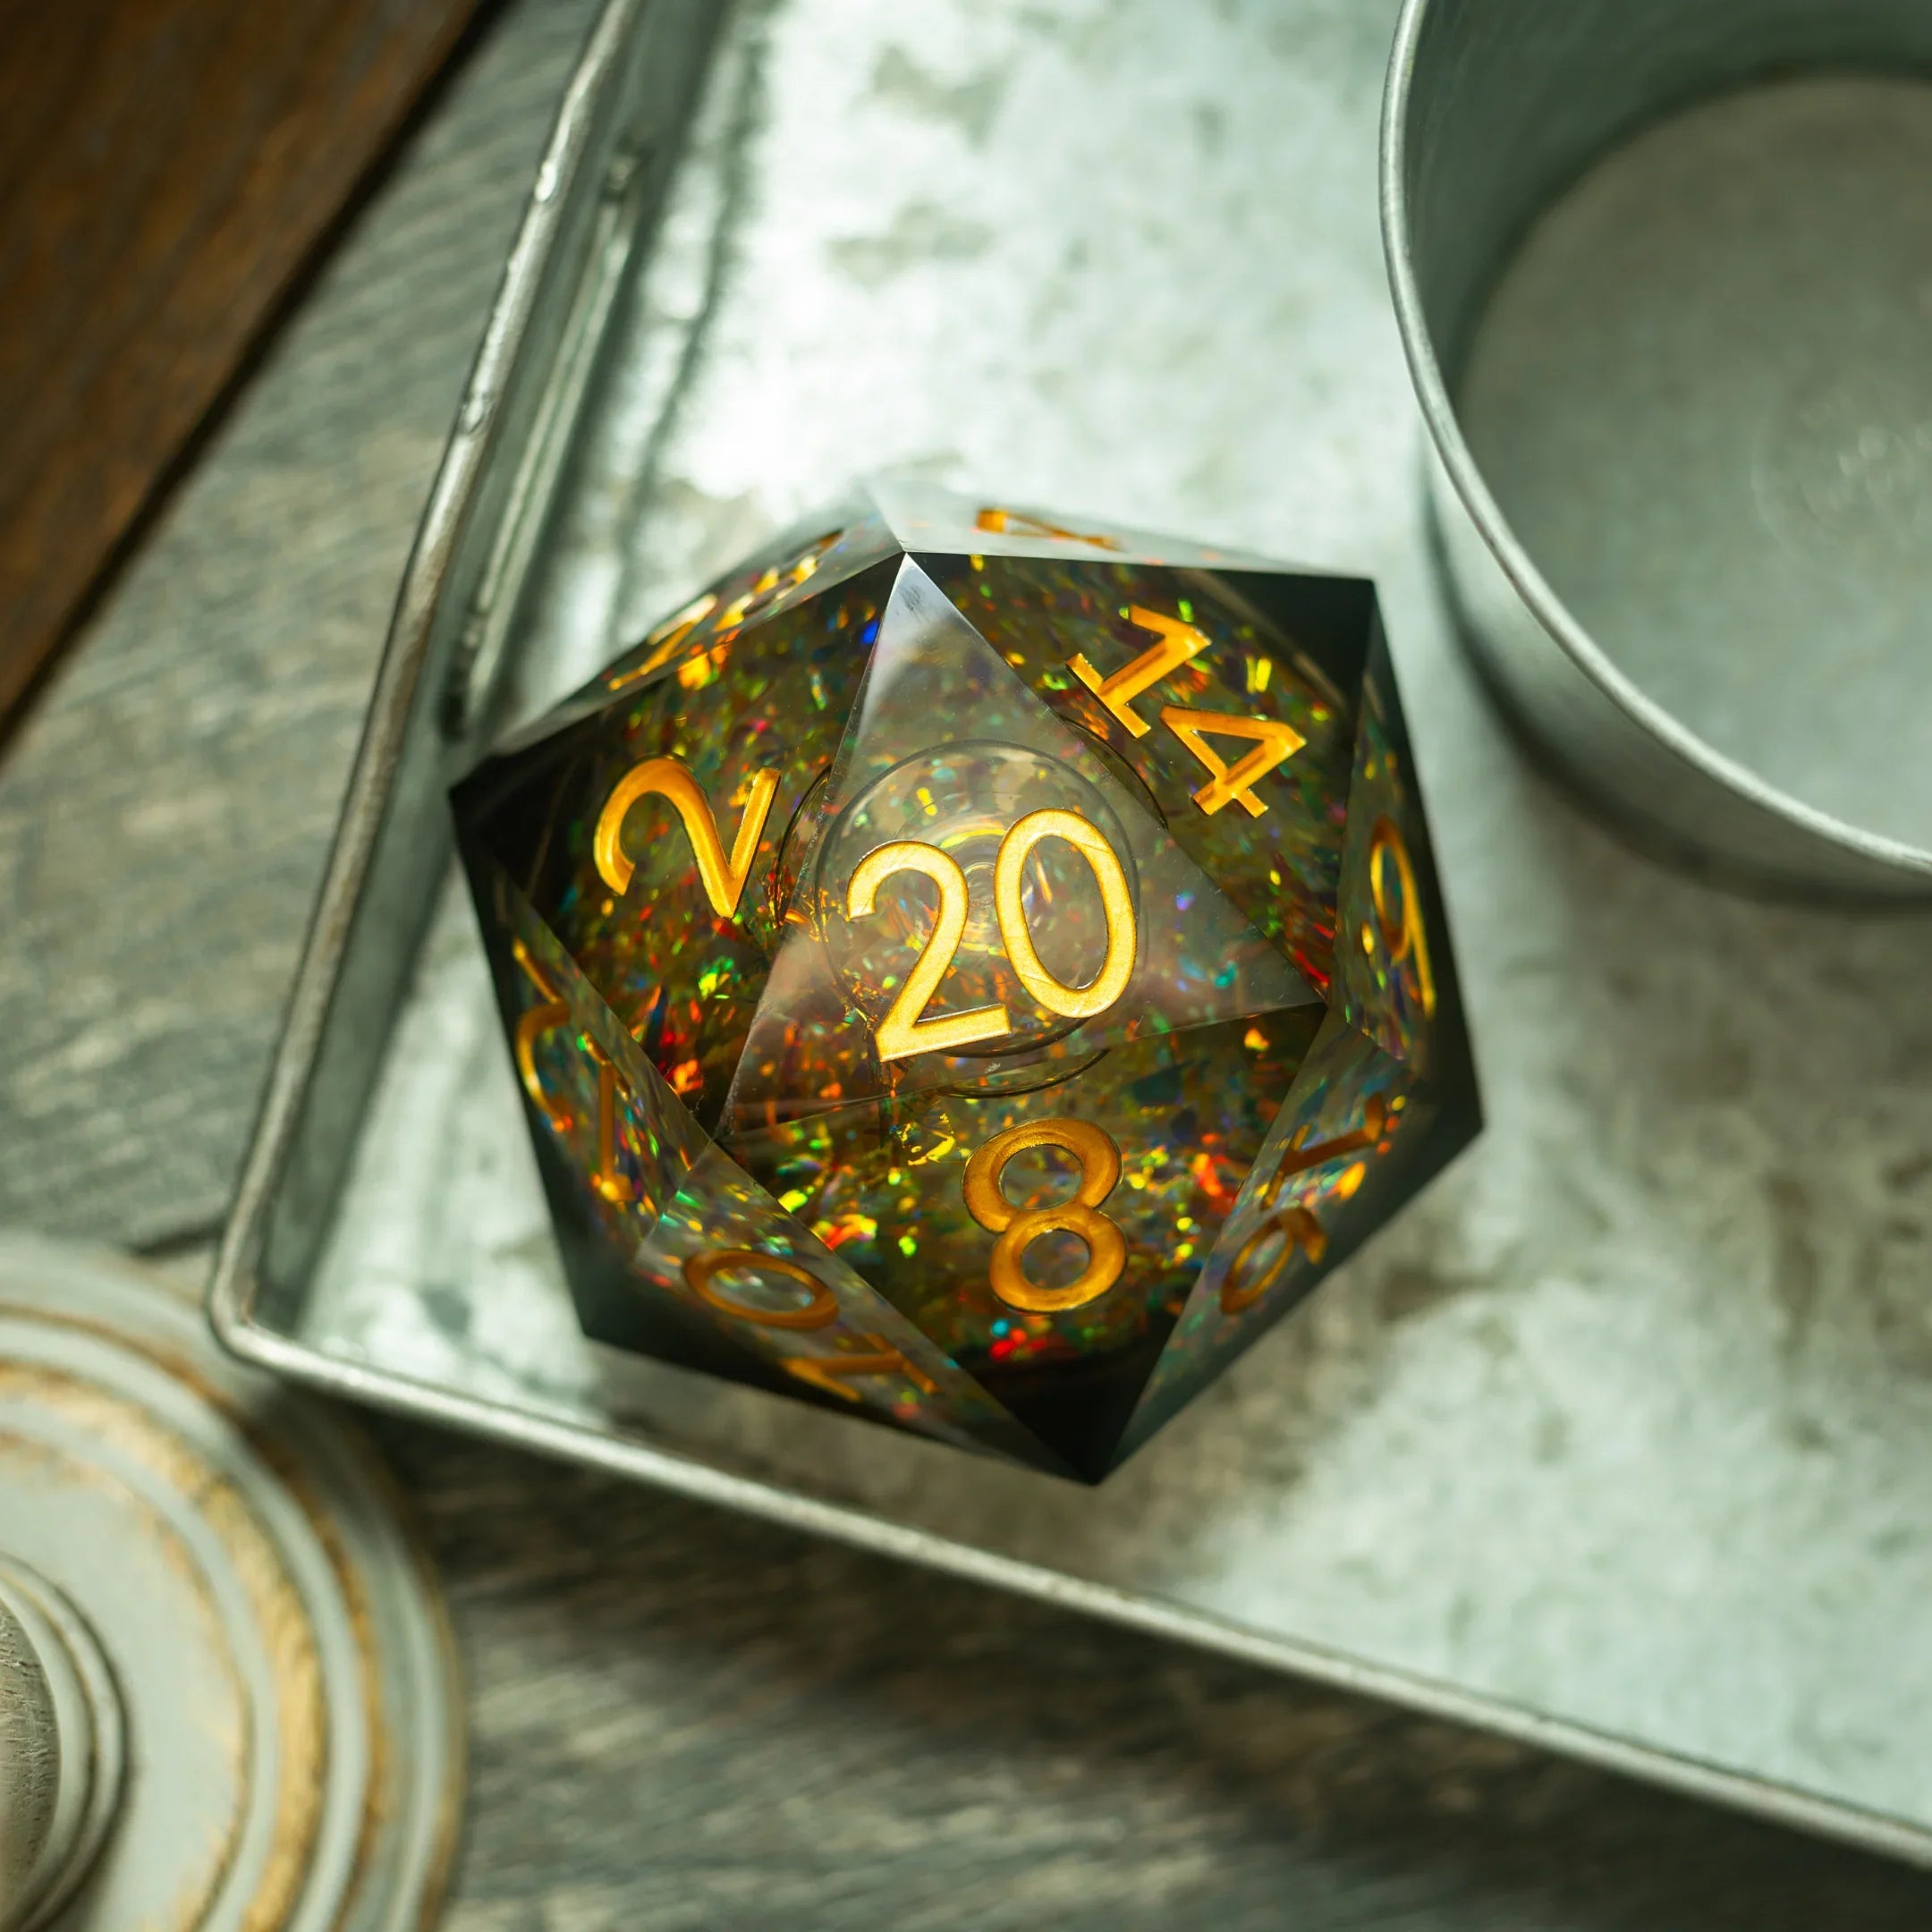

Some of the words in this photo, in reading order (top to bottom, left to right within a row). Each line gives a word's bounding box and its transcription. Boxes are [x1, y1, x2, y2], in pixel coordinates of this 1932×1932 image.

[1065, 605, 1307, 818] 14
[594, 755, 781, 919] 2
[846, 808, 1138, 1063] 20
[962, 1117, 1128, 1313] 8
[683, 1247, 937, 1401] 10
